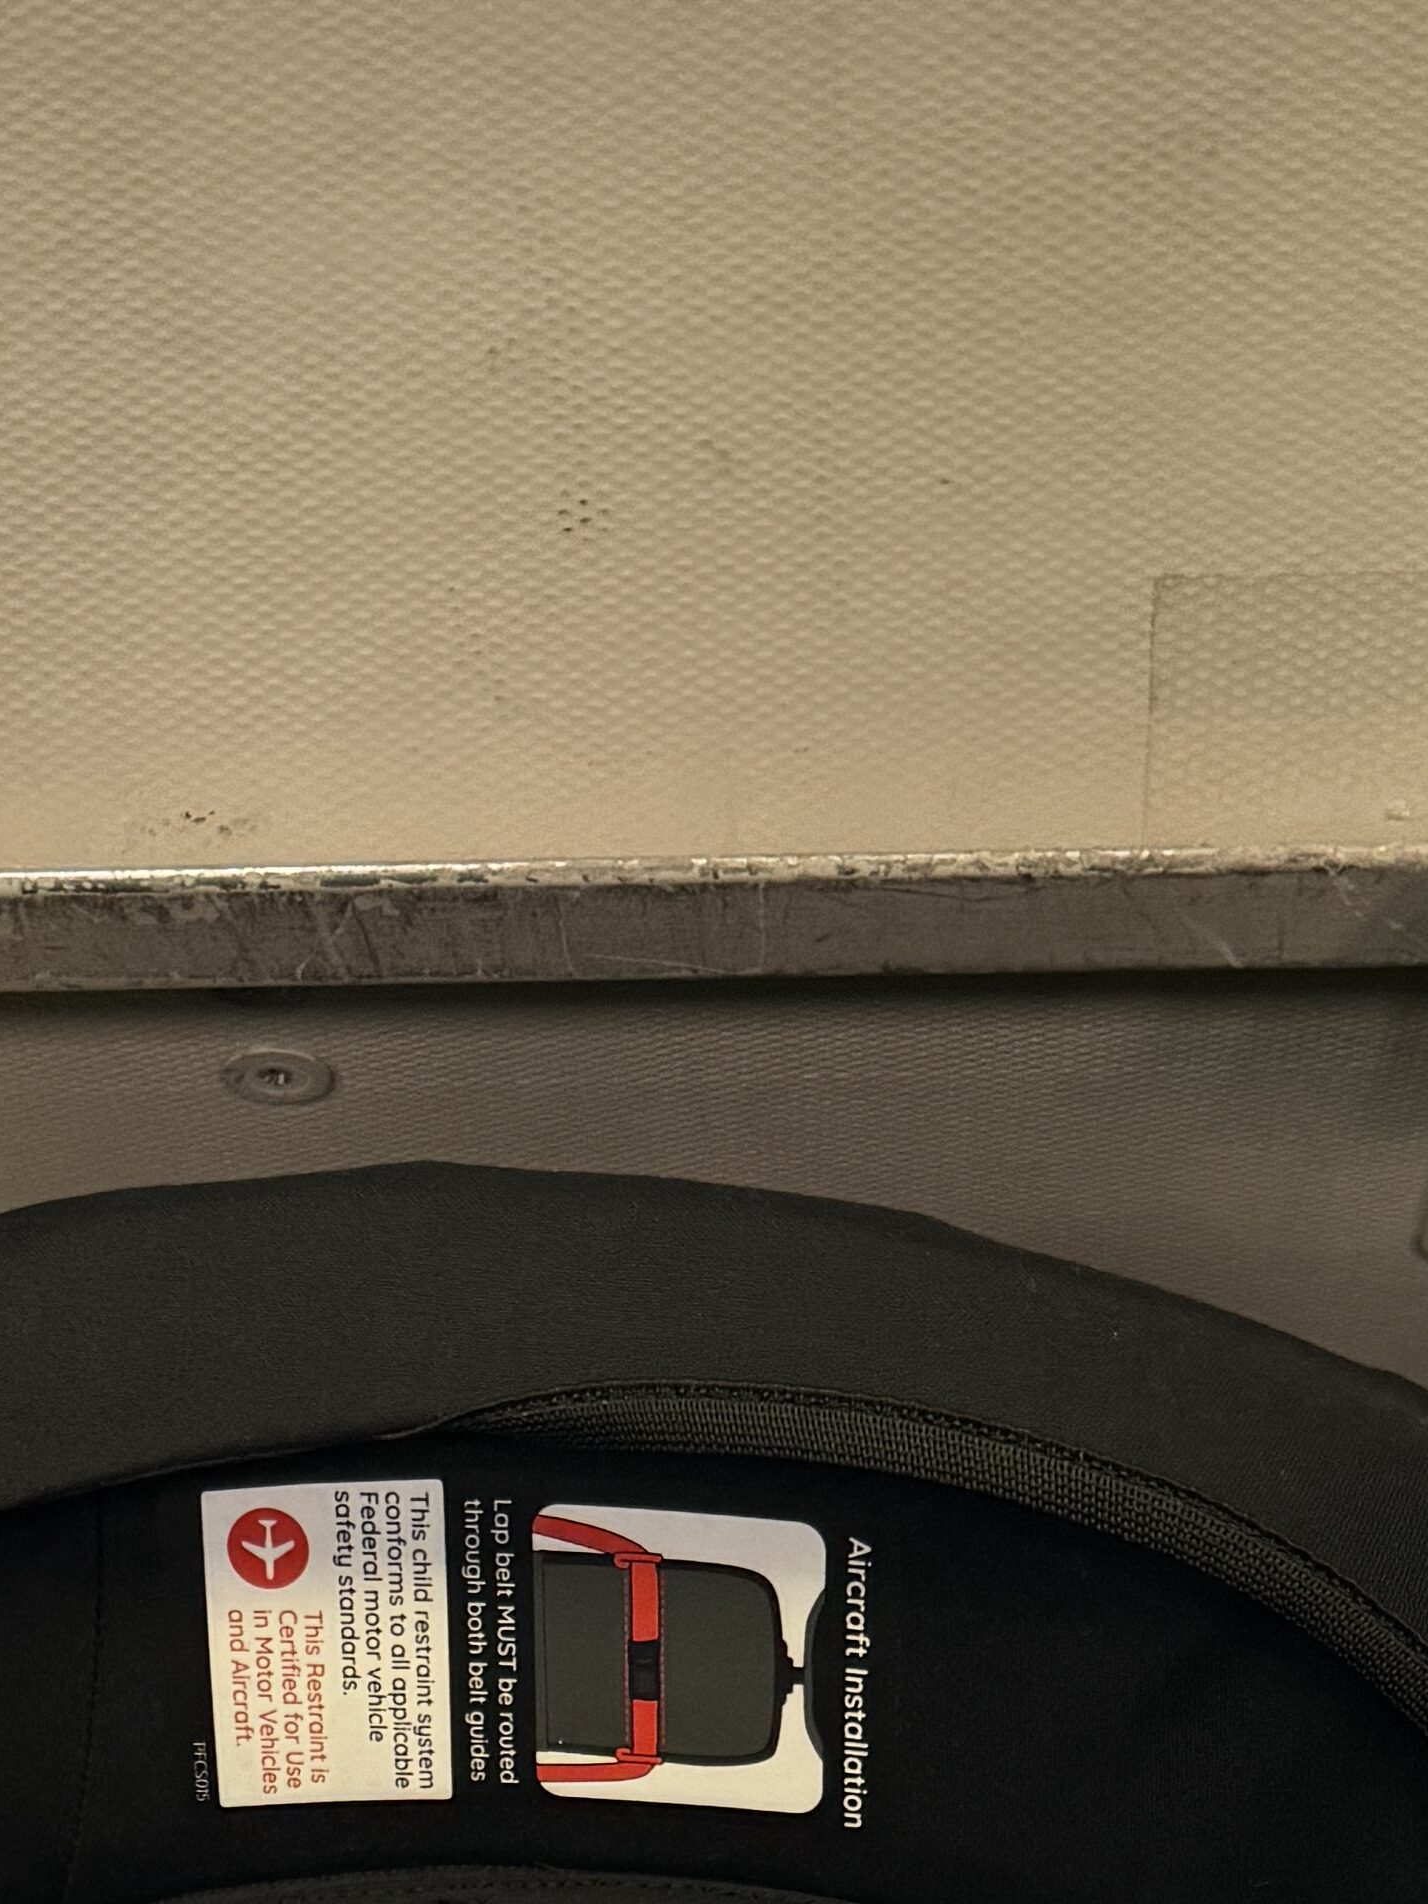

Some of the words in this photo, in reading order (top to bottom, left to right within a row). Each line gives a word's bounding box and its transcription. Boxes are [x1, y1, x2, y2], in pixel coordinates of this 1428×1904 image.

[333, 1491, 355, 1567] safety
[359, 1491, 383, 1582] Federal
[384, 1491, 408, 1606] conforms
[411, 1493, 430, 1541] This
[461, 1499, 487, 1594] through
[490, 1499, 512, 1545] Lap
[411, 1548, 434, 1602] child
[495, 1552, 516, 1597] belt
[845, 1537, 872, 1658] Aircraft
[227, 1609, 250, 1653] and
[254, 1610, 270, 1627] in
[303, 1609, 325, 1656] This
[339, 1575, 359, 1695] standards.
[363, 1589, 383, 1661] motor
[389, 1613, 407, 1637] to
[467, 1601, 488, 1655] both
[497, 1605, 517, 1672] MUST
[254, 1636, 274, 1703] Motor
[278, 1609, 302, 1705] Certified
[390, 1644, 411, 1670] all
[414, 1610, 434, 1706] restraint
[468, 1662, 489, 1704] belt
[497, 1678, 518, 1706] be
[231, 1659, 254, 1747] Aircraft.
[283, 1713, 300, 1744] for
[306, 1663, 327, 1762] Restraint
[367, 1667, 389, 1743] vehicle
[389, 1678, 412, 1788] applicable
[258, 1709, 282, 1795] Vehicles
[285, 1751, 305, 1789] Use
[310, 1768, 330, 1784] is
[412, 1713, 435, 1789] system
[464, 1711, 490, 1782] guides
[498, 1712, 520, 1784] routed
[843, 1667, 869, 1828] Installation
